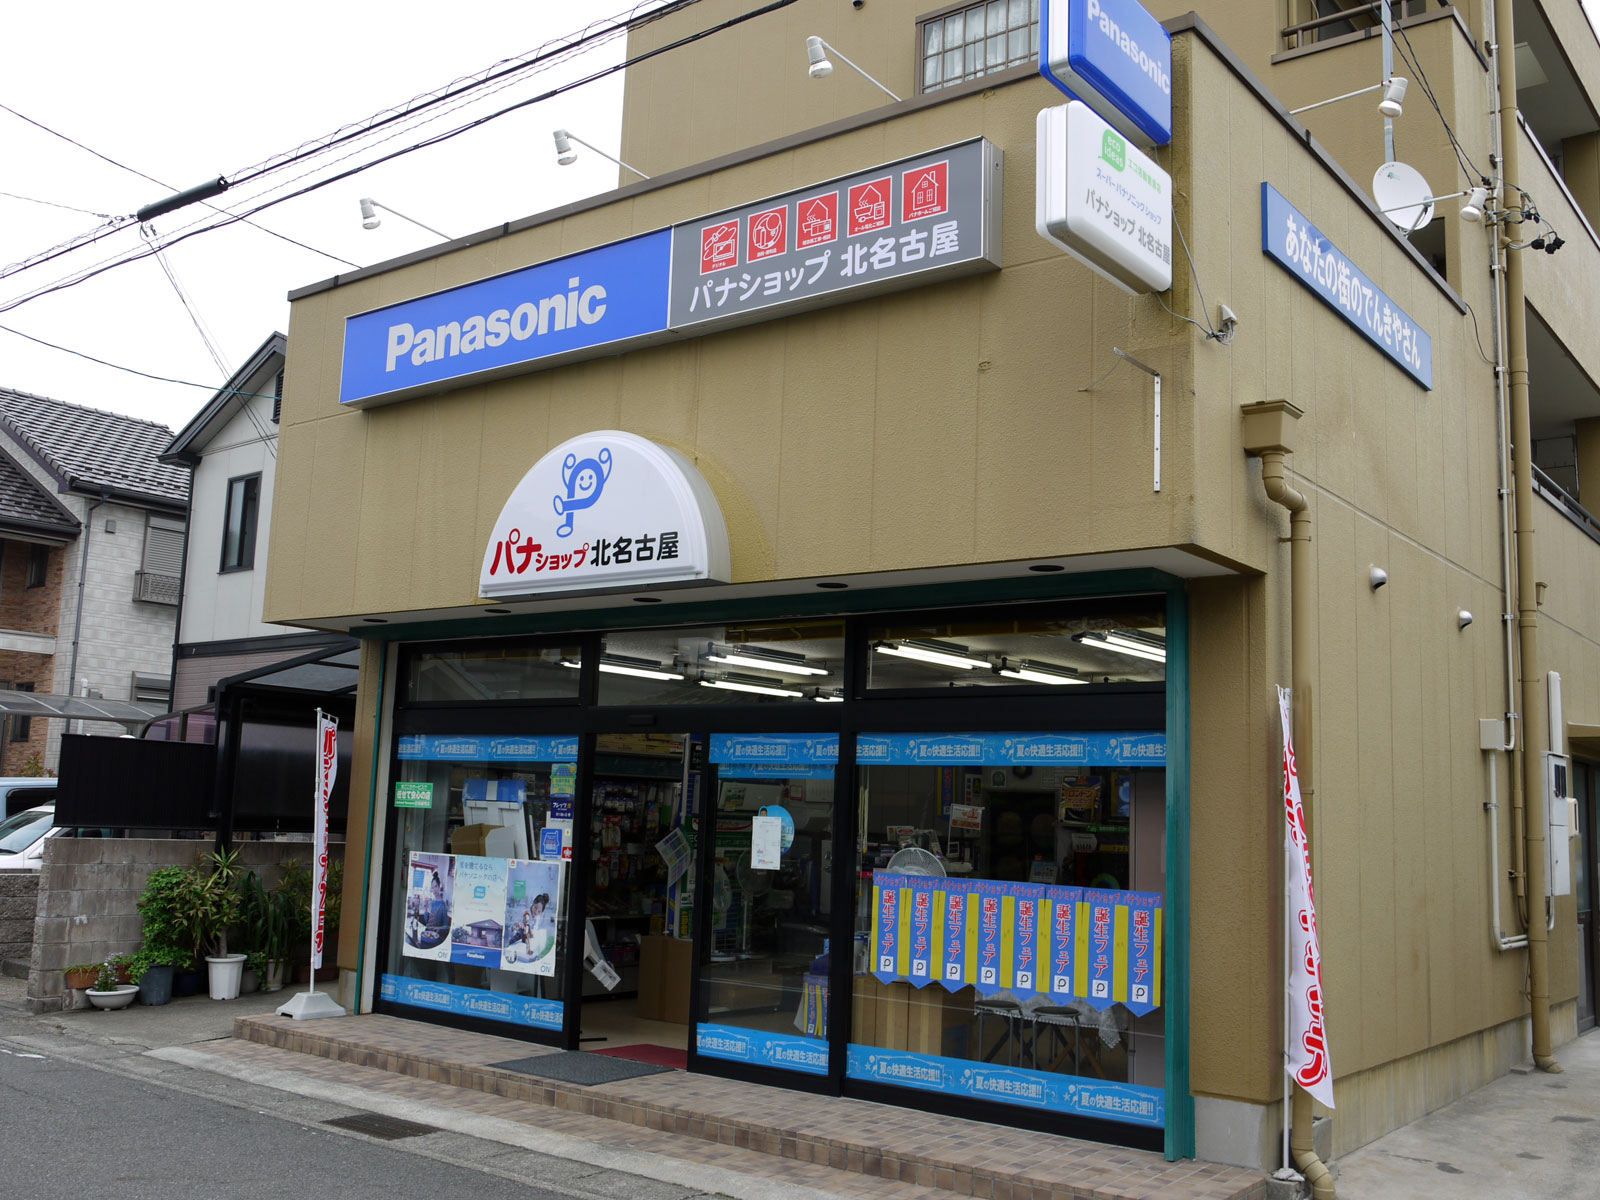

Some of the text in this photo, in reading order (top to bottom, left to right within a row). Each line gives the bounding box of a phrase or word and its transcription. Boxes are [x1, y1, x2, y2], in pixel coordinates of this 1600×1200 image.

[1087, 0, 1170, 95] Panasonic
[1104, 144, 1124, 167] ideas
[1107, 135, 1121, 153] eco
[689, 220, 960, 312] パナショップ 北名古屋
[1285, 212, 1421, 370] あなたの街のでんきやさん
[385, 276, 607, 373] Panasonic
[882, 890, 896, 954] 誕生フェア
[915, 892, 929, 958] 誕生フェア
[948, 895, 963, 962] 誕生フェア
[983, 897, 997, 965] 誕生フェア
[1018, 900, 1034, 969] 誕生フェア
[1056, 904, 1071, 974] 誕生フェア
[1094, 907, 1110, 978] 誕生フェア
[1133, 910, 1149, 983] 誕生フェア
